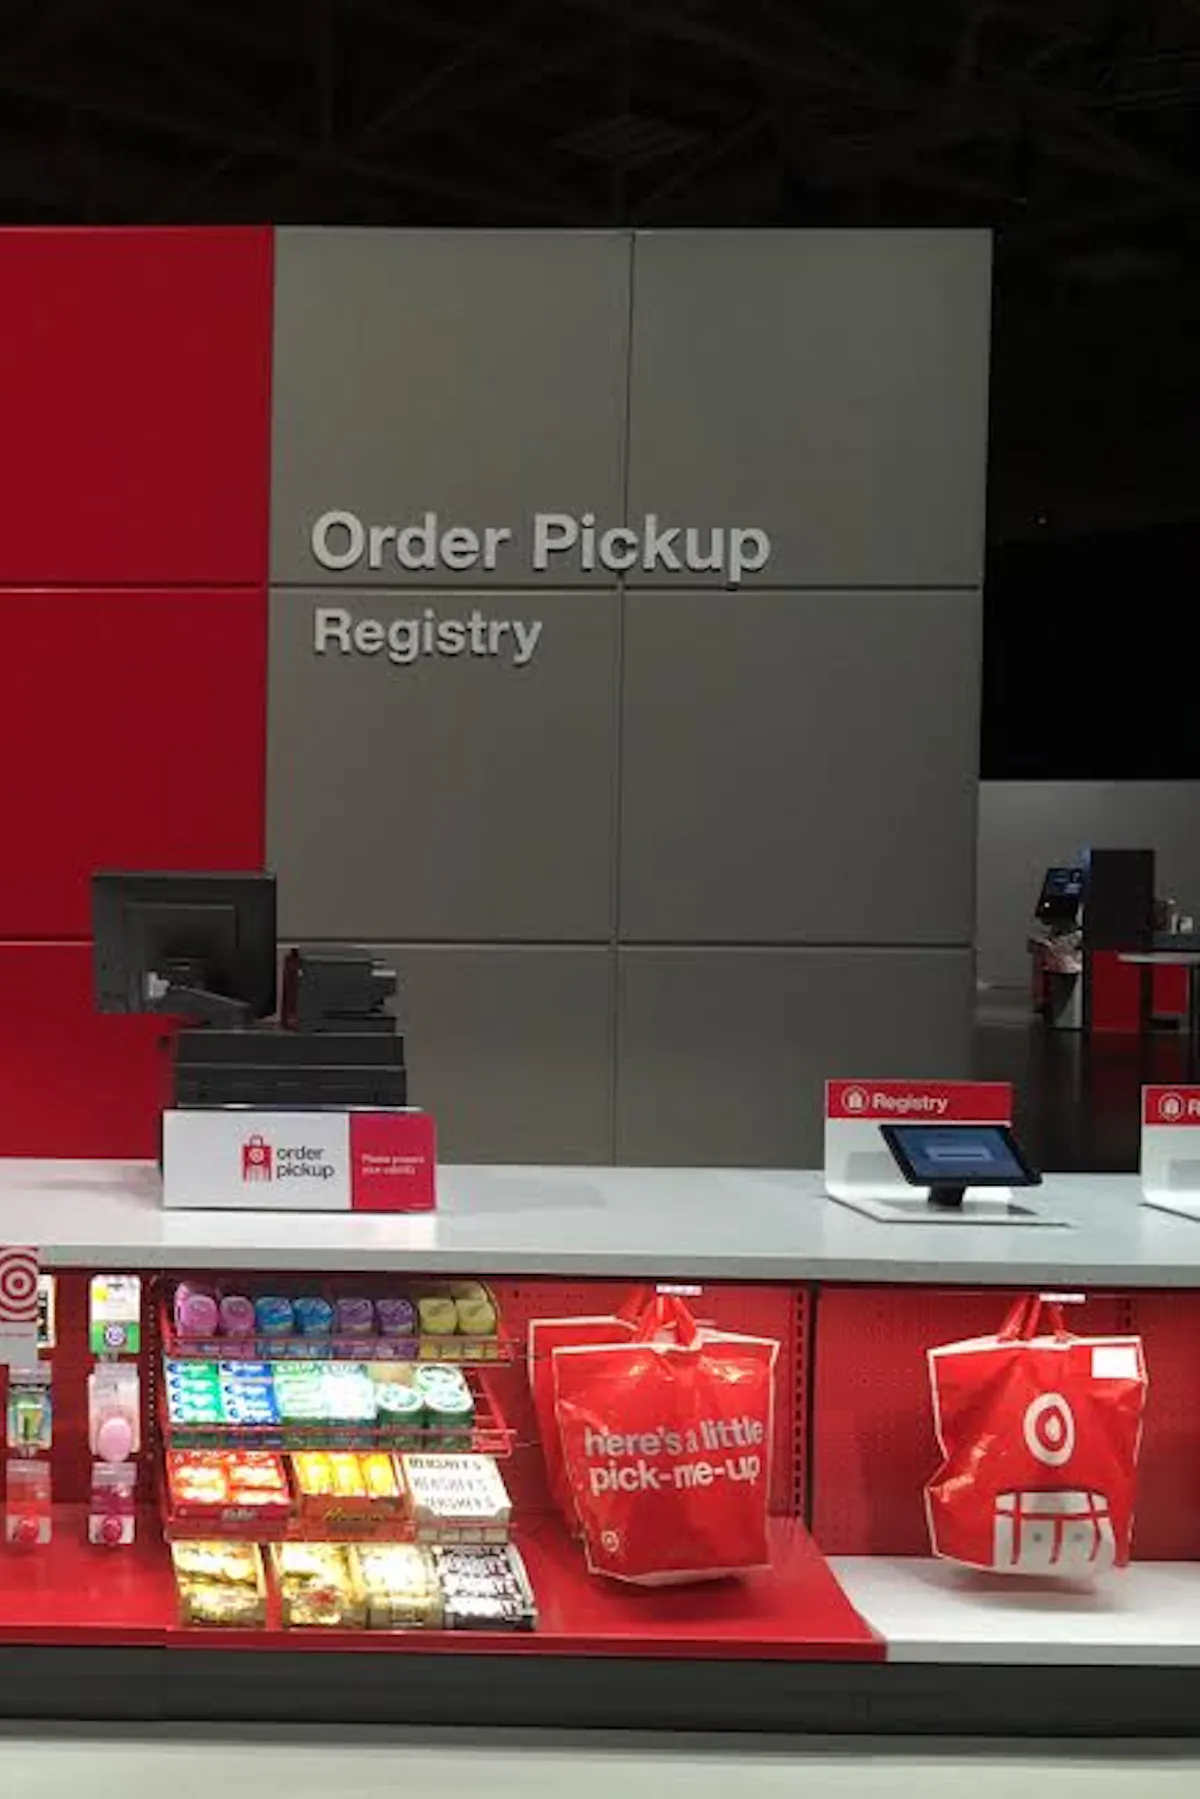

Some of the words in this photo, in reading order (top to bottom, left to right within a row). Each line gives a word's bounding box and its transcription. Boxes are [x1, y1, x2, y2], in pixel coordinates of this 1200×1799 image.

[311, 510, 511, 570] Order
[532, 512, 772, 585] Pickup
[313, 607, 543, 665] Registry
[872, 1092, 949, 1114] Registry
[276, 1146, 324, 1160] order
[276, 1162, 335, 1179] pickup
[585, 1424, 683, 1457] here's
[700, 1415, 764, 1450] little
[589, 1455, 761, 1497] pick-me-up
